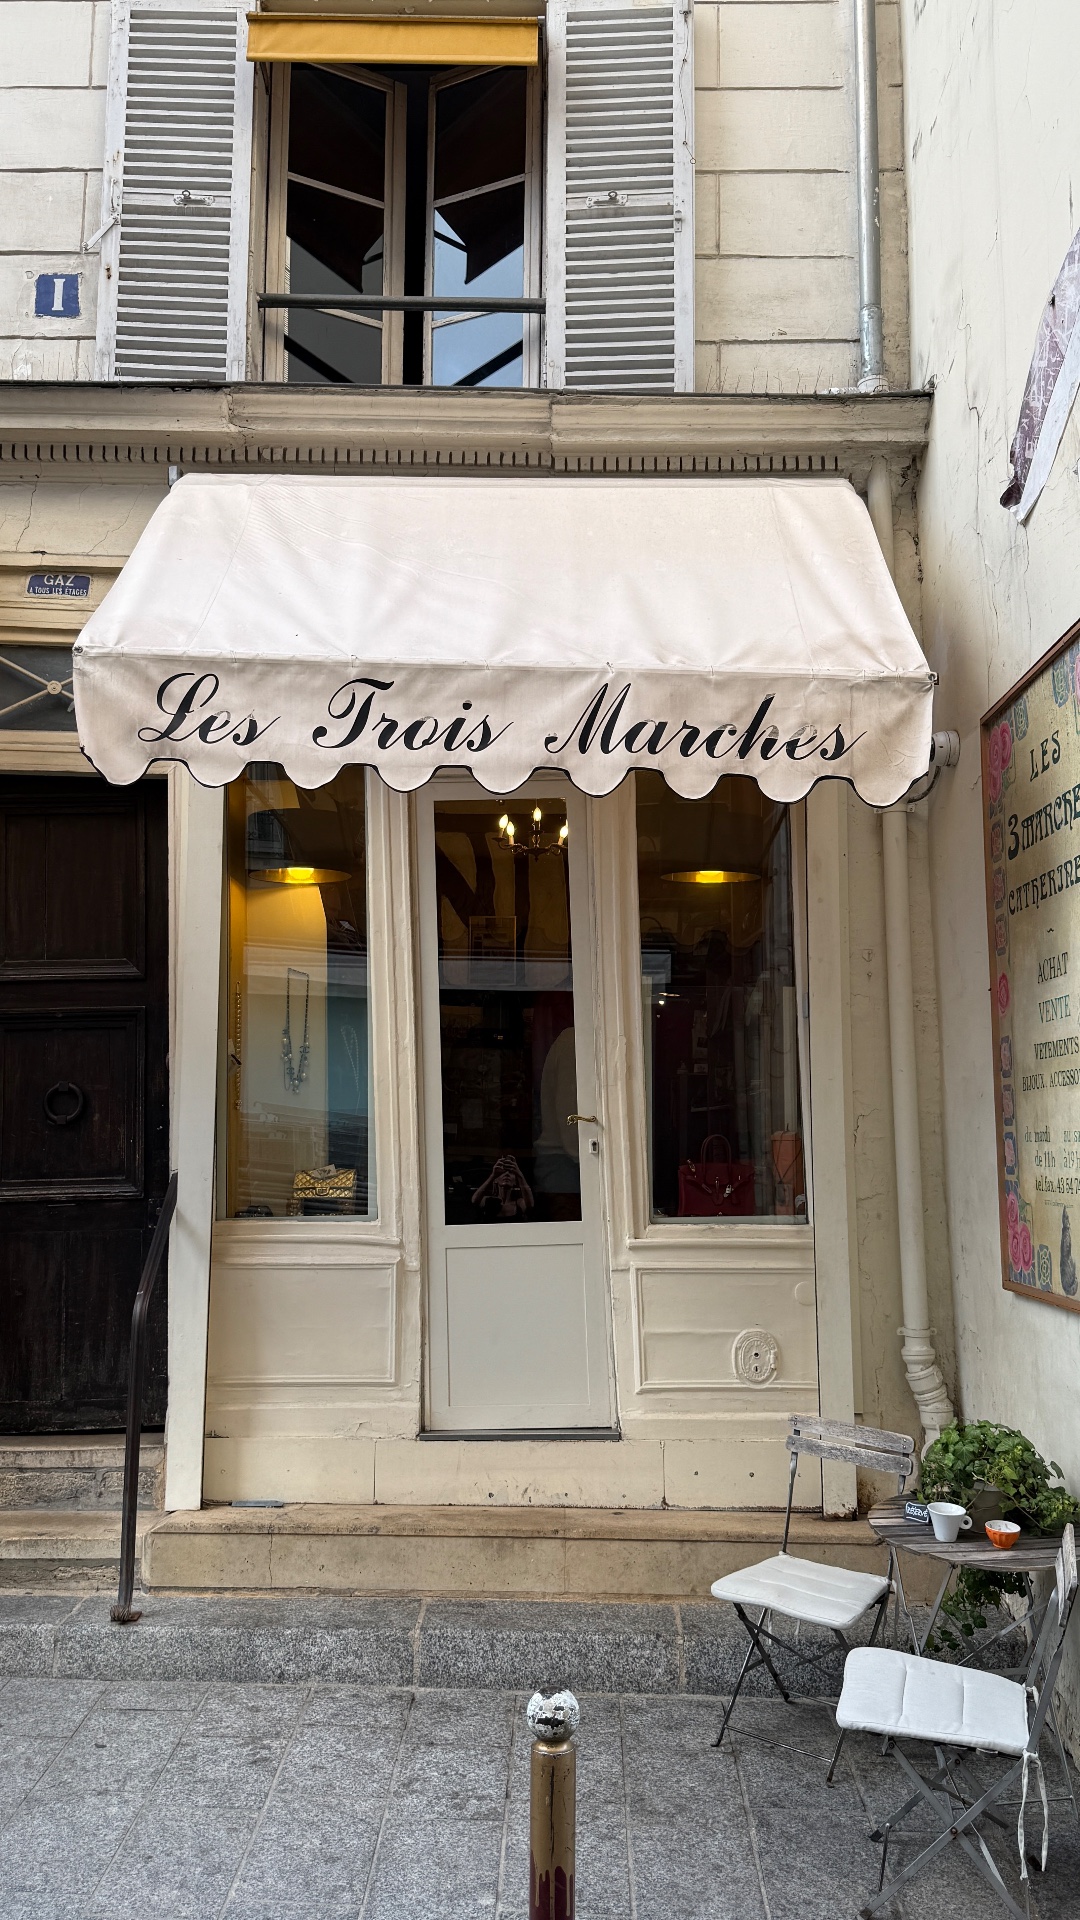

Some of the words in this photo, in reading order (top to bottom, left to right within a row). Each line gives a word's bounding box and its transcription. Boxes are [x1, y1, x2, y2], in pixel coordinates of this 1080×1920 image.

[35, 586, 50, 594] TOUS
[52, 587, 63, 595] LES
[65, 586, 87, 596] ÉTAGES
[43, 574, 77, 587] GAZ
[138, 672, 281, 747] Les
[312, 677, 514, 752] Trois
[544, 683, 867, 761] Marches
[1029, 730, 1061, 782] LES
[1038, 952, 1069, 984] ACHAT
[1038, 994, 1071, 1024] VENTE
[1050, 1068, 1080, 1088] ACCESSO
[1034, 1149, 1042, 1167] de
